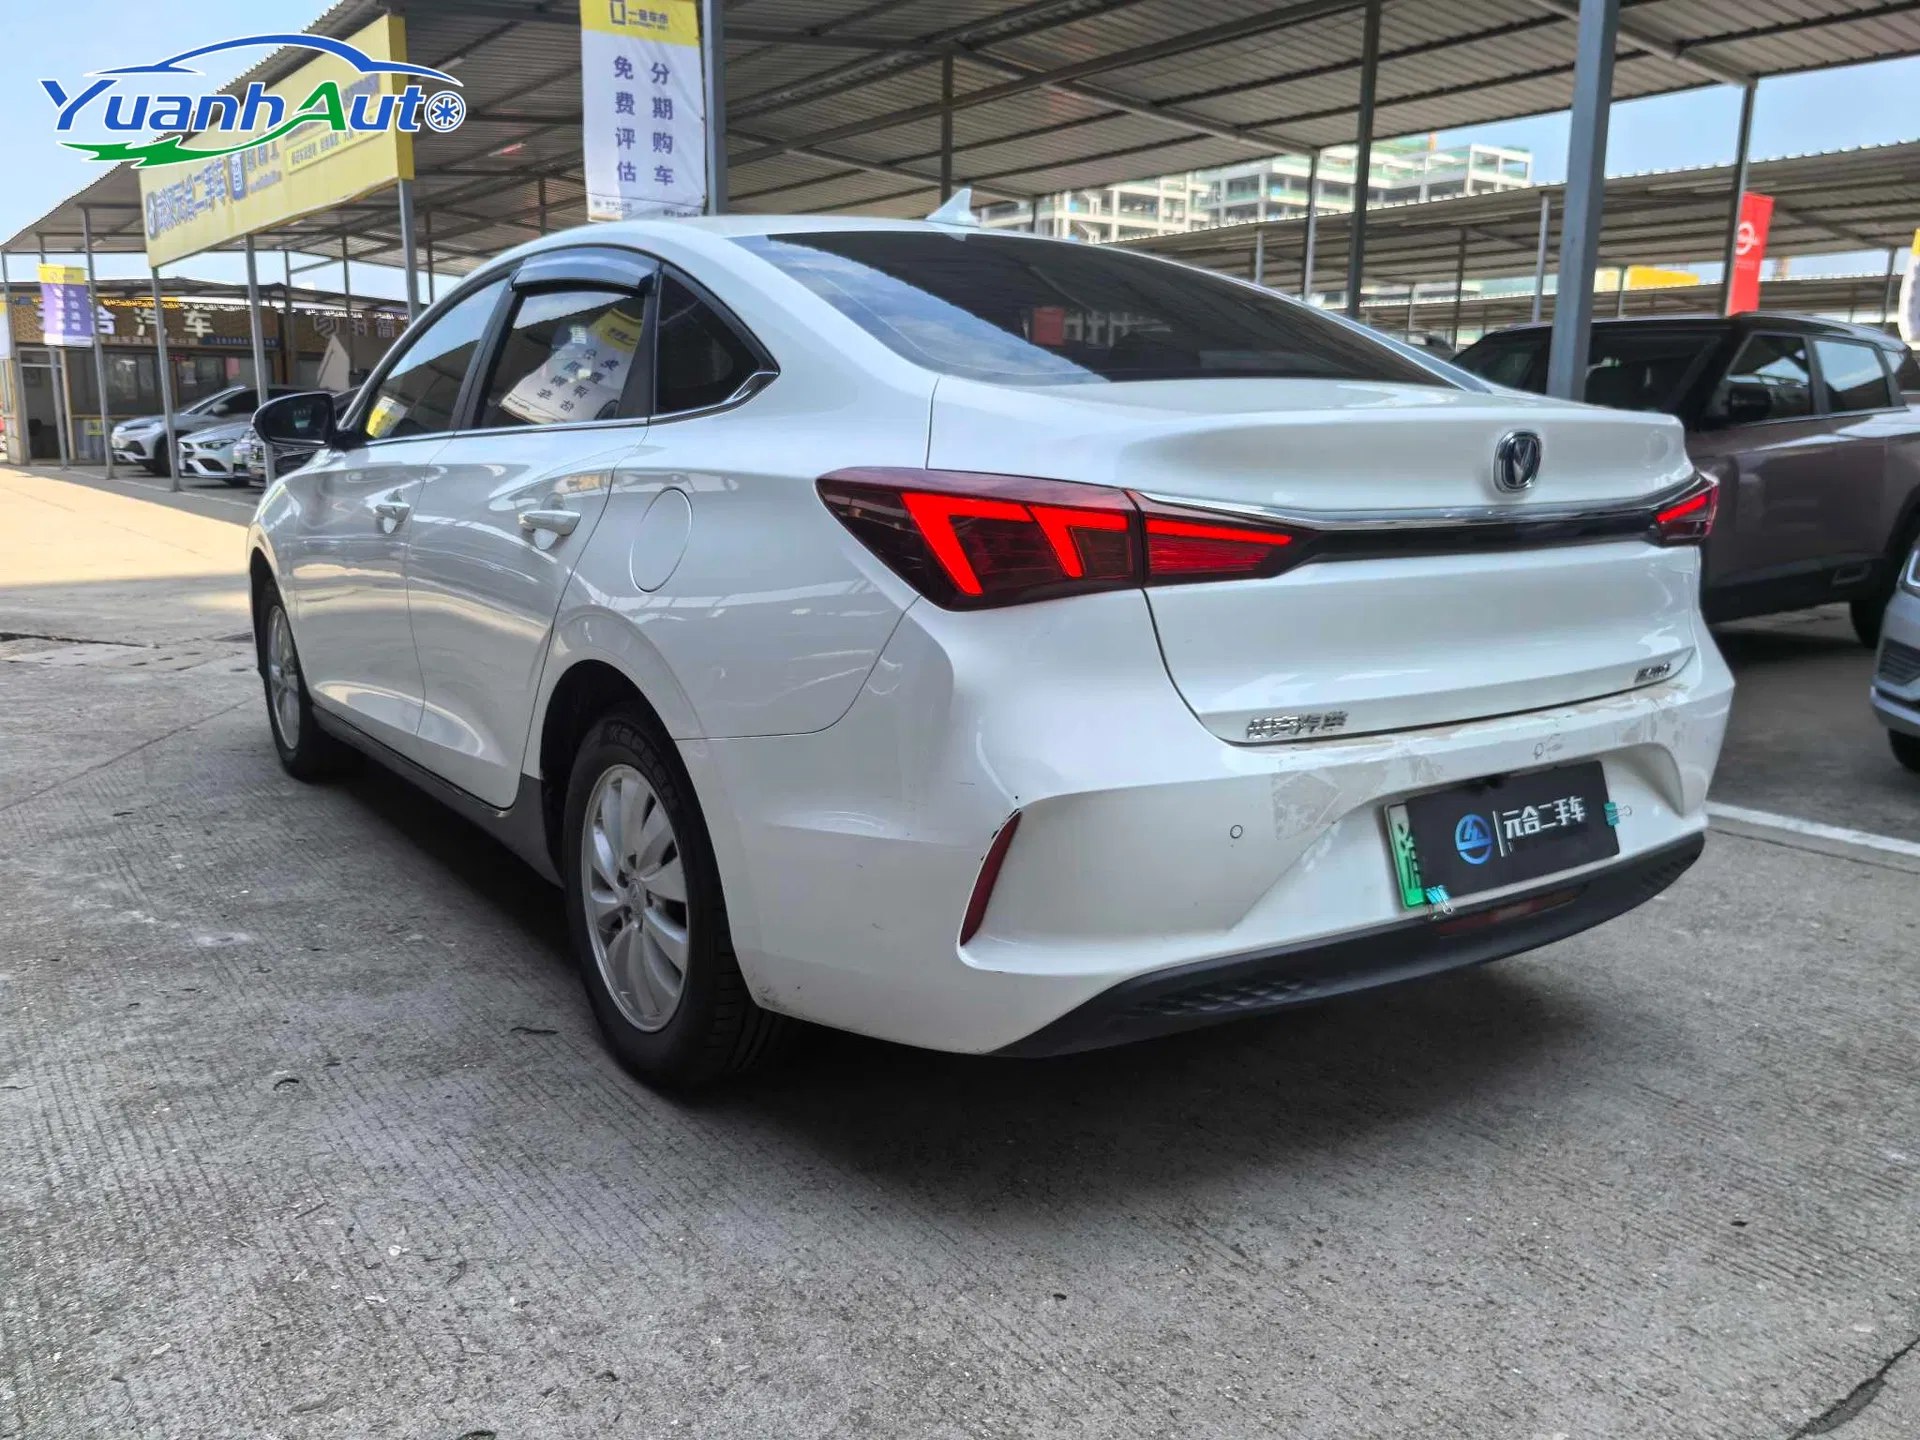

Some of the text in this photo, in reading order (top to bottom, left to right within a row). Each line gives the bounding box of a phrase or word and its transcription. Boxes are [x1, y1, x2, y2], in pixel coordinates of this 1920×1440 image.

[613, 55, 637, 184] 免费评估
[651, 62, 675, 186] 分期购车
[1502, 795, 1587, 839] 元合二手车
